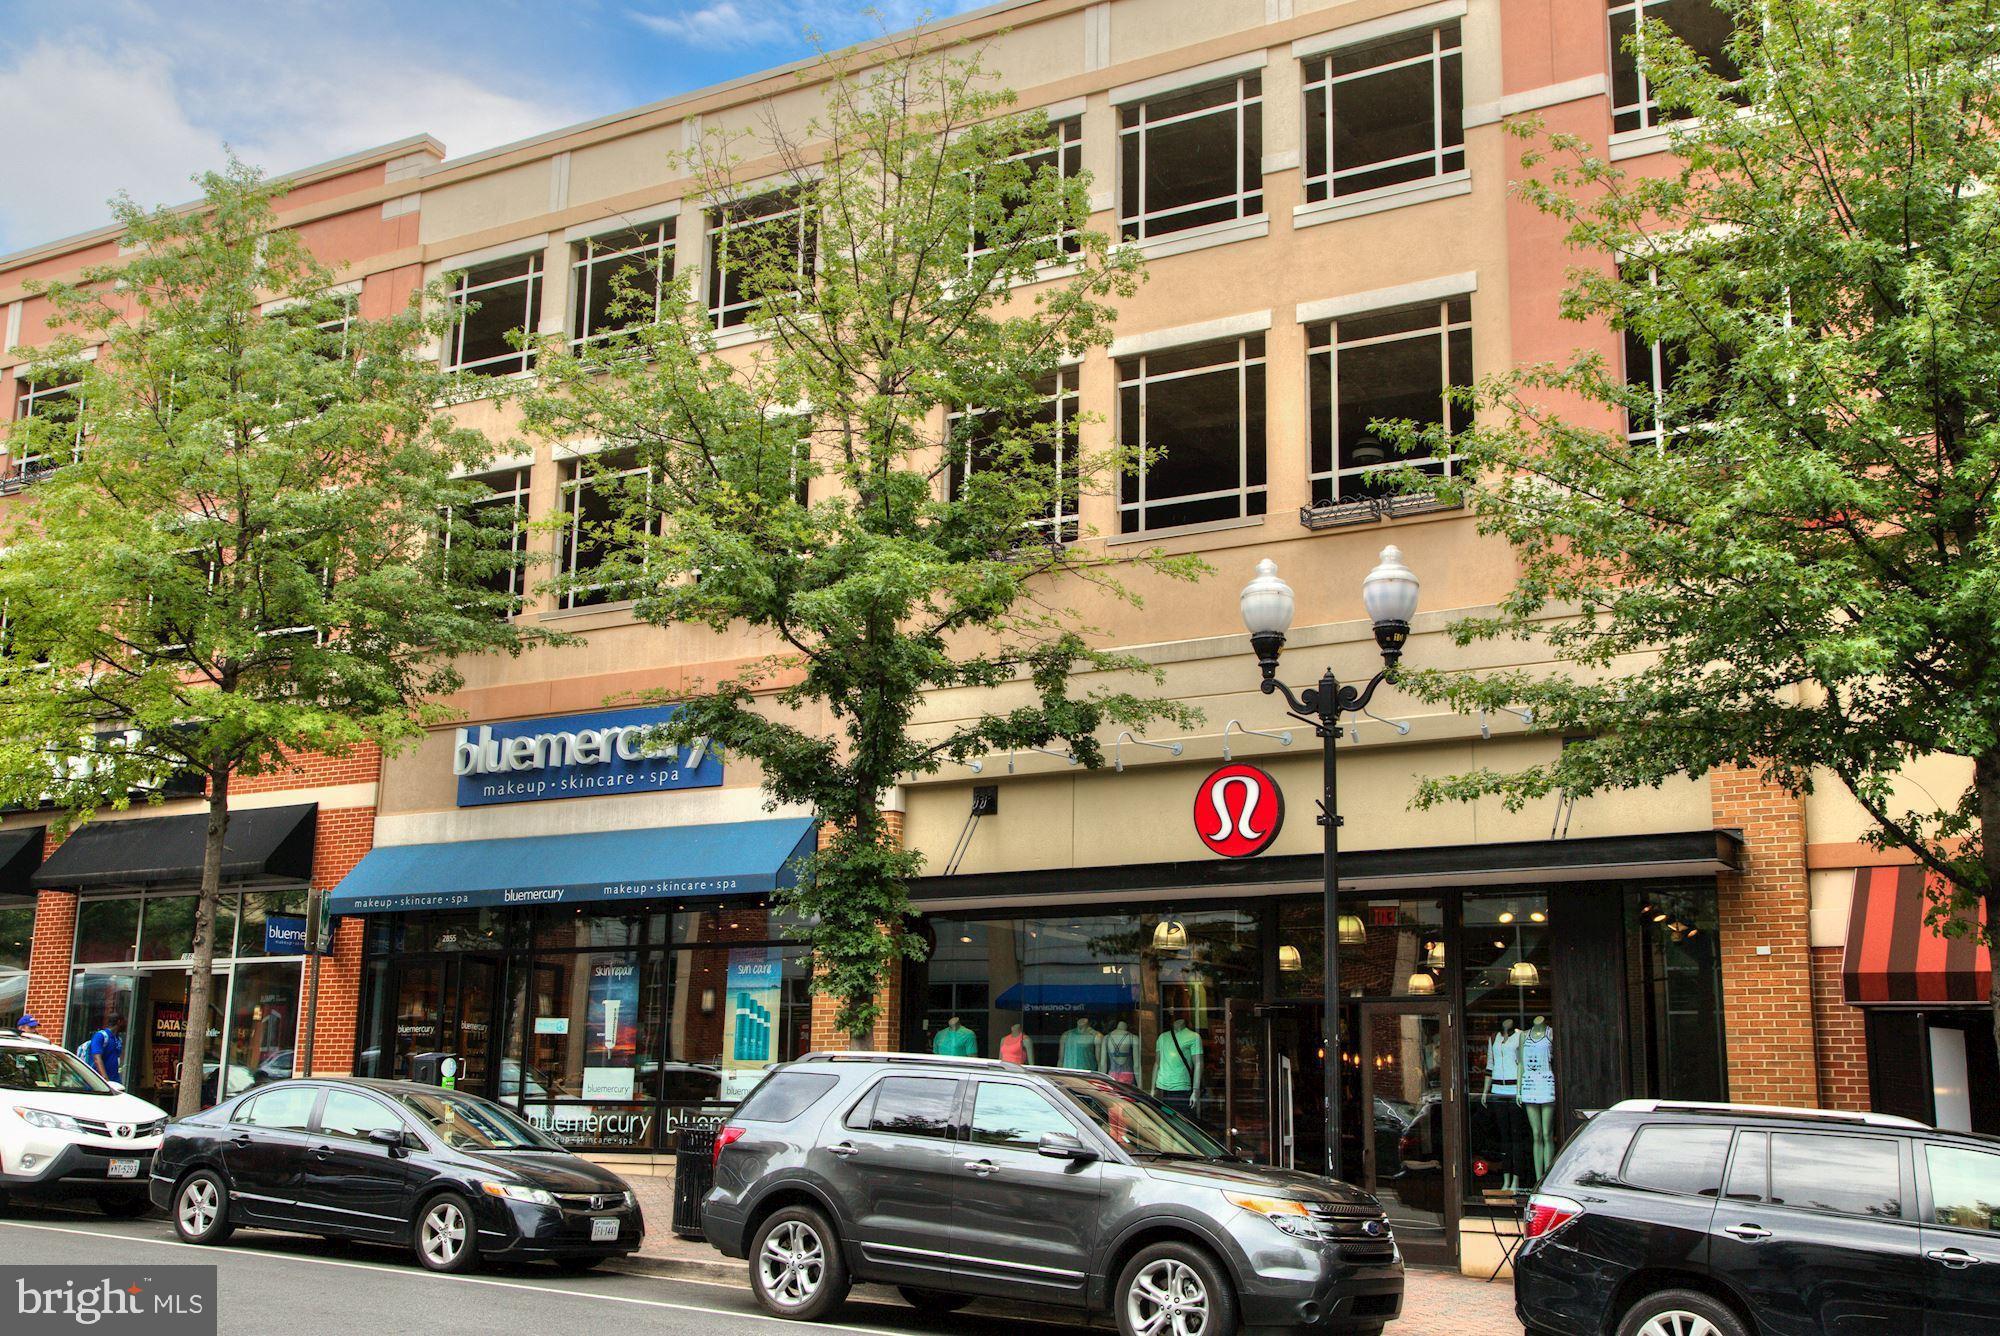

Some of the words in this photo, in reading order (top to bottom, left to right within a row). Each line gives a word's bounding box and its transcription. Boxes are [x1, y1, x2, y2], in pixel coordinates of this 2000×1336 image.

[483, 780, 546, 797] makeup
[560, 773, 634, 789] skincare
[650, 770, 679, 785] spa
[604, 884, 647, 895] makeup
[656, 880, 707, 892] skincare
[716, 879, 737, 891] spa
[354, 898, 392, 909] makeup
[400, 895, 443, 906] skincare
[451, 894, 468, 905] spa
[504, 888, 565, 902] bluemercury
[737, 964, 751, 975] sun
[752, 963, 772, 975] care
[156, 1018, 181, 1031] DATA
[398, 1024, 435, 1034] bluemercury
[587, 1083, 629, 1095] bluemercury
[528, 1108, 652, 1140] bluemercury
